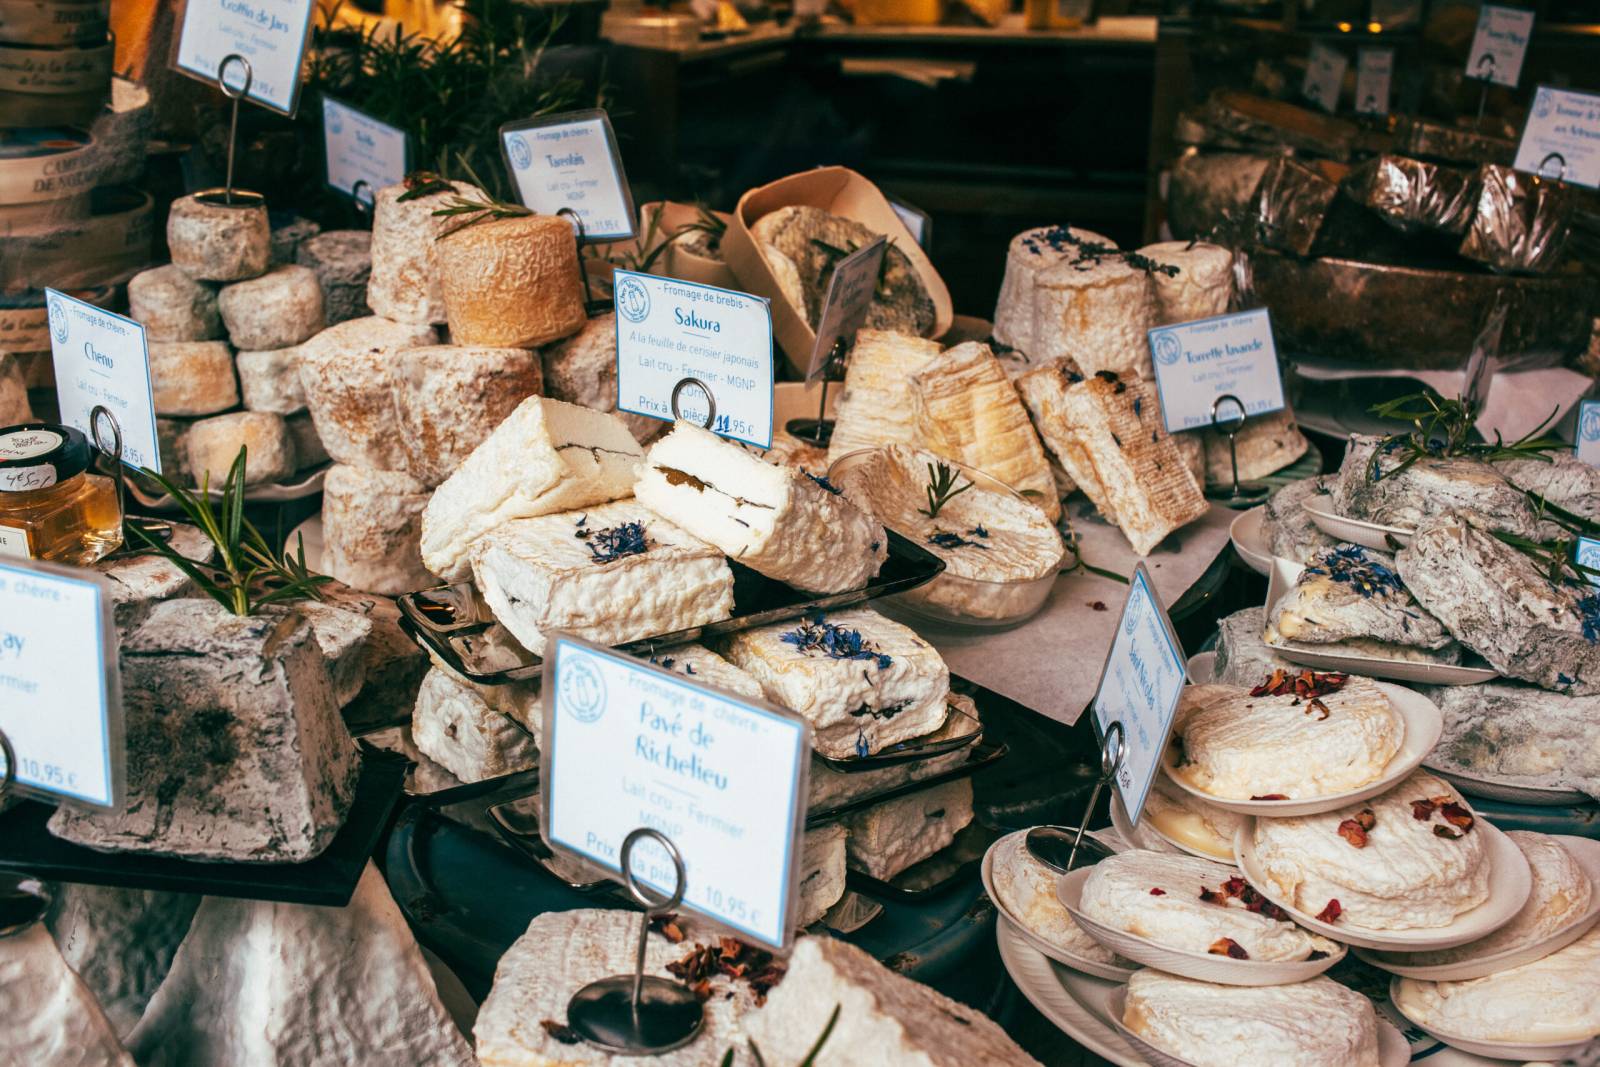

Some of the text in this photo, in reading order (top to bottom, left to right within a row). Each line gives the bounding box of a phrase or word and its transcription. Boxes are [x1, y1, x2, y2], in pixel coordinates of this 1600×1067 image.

[664, 283, 743, 309] Fromage de brebis
[73, 306, 98, 326] Fromage
[98, 317, 105, 329] de
[674, 307, 721, 333] Sakura
[84, 341, 114, 369] Chenu
[638, 332, 646, 344] la
[648, 335, 674, 349] feuille
[676, 340, 687, 352] de
[638, 355, 756, 391] Lait cru Fermier MGNP
[639, 395, 659, 412] Prix
[661, 400, 668, 414] à
[3, 633, 25, 658] ay
[629, 672, 686, 708] Fromage
[689, 690, 706, 710] de
[640, 701, 714, 749] Pavé de
[635, 735, 728, 791] Richelieu
[622, 775, 744, 839] Lait cru Fermier
[586, 831, 615, 858] Prix
[706, 885, 747, 918] 10,95
